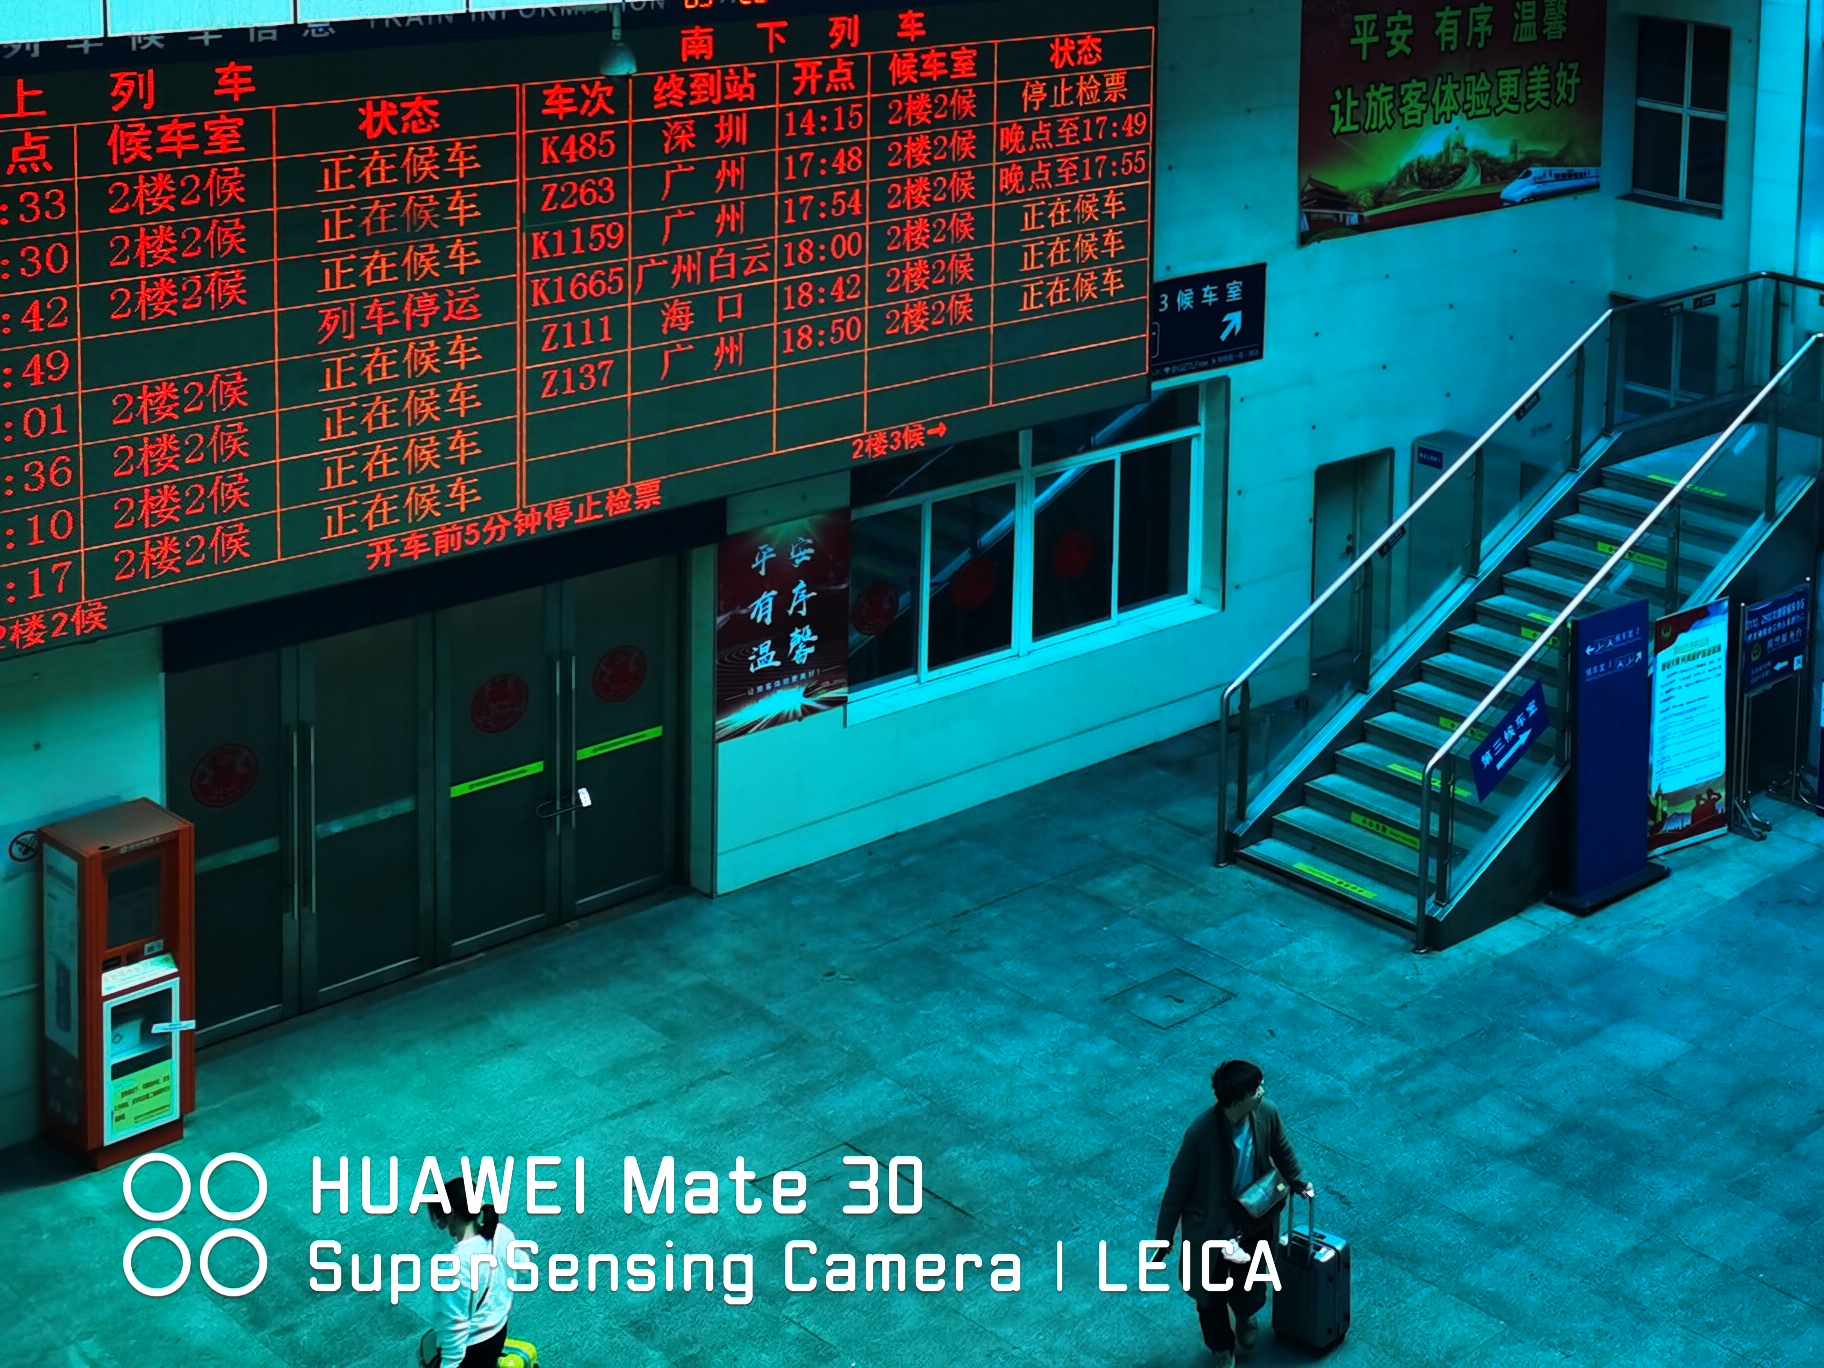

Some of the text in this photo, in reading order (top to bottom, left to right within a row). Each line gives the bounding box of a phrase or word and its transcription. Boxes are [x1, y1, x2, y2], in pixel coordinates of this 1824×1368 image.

[680, 9, 926, 63] 南下列车
[1350, 9, 1414, 61] 平安
[1435, 2, 1494, 52] 有序
[107, 114, 246, 166] 候车室
[358, 97, 440, 140] 状态
[541, 78, 615, 118] 车次
[653, 65, 756, 111] 终到站
[793, 58, 855, 96] 开点
[887, 46, 978, 86] 候车室
[1048, 35, 1103, 69] 状态
[107, 166, 246, 216] 2楼2候
[317, 140, 481, 194] 正在候车
[541, 131, 616, 165] K485
[785, 103, 864, 138] 14:15
[887, 87, 977, 127] 2楼2候
[1021, 69, 1127, 115] 停止检票
[1329, 61, 1581, 136] 让旅客体验更美好
[108, 216, 247, 269] 2楼2候
[317, 189, 481, 244] 正在候车
[541, 177, 616, 213] Z263
[784, 146, 864, 181] 17:48
[887, 128, 977, 169] 2楼2候
[999, 112, 1148, 157] 晚点至17:49
[109, 268, 248, 321] 2楼2候
[317, 238, 481, 295] 正在候车
[531, 220, 625, 259] K1159
[784, 191, 862, 226] 17:54
[886, 170, 976, 211] 2楼2候
[998, 150, 1147, 196] 晚点至17:55
[317, 286, 481, 346] 列车停运
[531, 268, 625, 306] K1665
[634, 245, 772, 296] 广州白云
[783, 234, 862, 268] 18:00
[885, 211, 975, 252] 2楼2候
[1019, 189, 1125, 234] 正在候车
[111, 370, 249, 426] 2楼2候
[320, 334, 482, 392] 正在候车
[541, 315, 613, 352] Z111
[783, 275, 862, 312] 18:42
[885, 253, 973, 294] 2楼2候
[1019, 228, 1125, 274] 正在候车
[112, 420, 250, 478] 2楼2候
[319, 382, 482, 442] 正在候车
[541, 360, 615, 400] Z137
[782, 316, 862, 355] 18:50
[885, 293, 973, 337] 2楼2候
[1019, 267, 1125, 312] 正在候车
[113, 471, 250, 530] 2楼2候
[319, 429, 482, 491] 正在候车
[853, 424, 925, 460] 2楼3候
[113, 521, 250, 582] 2楼2候
[323, 477, 482, 542] 正在候车
[365, 478, 663, 572] 开车前5分钟停止检票
[751, 537, 815, 576] 平安
[749, 579, 819, 625] 有序
[1481, 699, 1538, 769] 第三候车室
